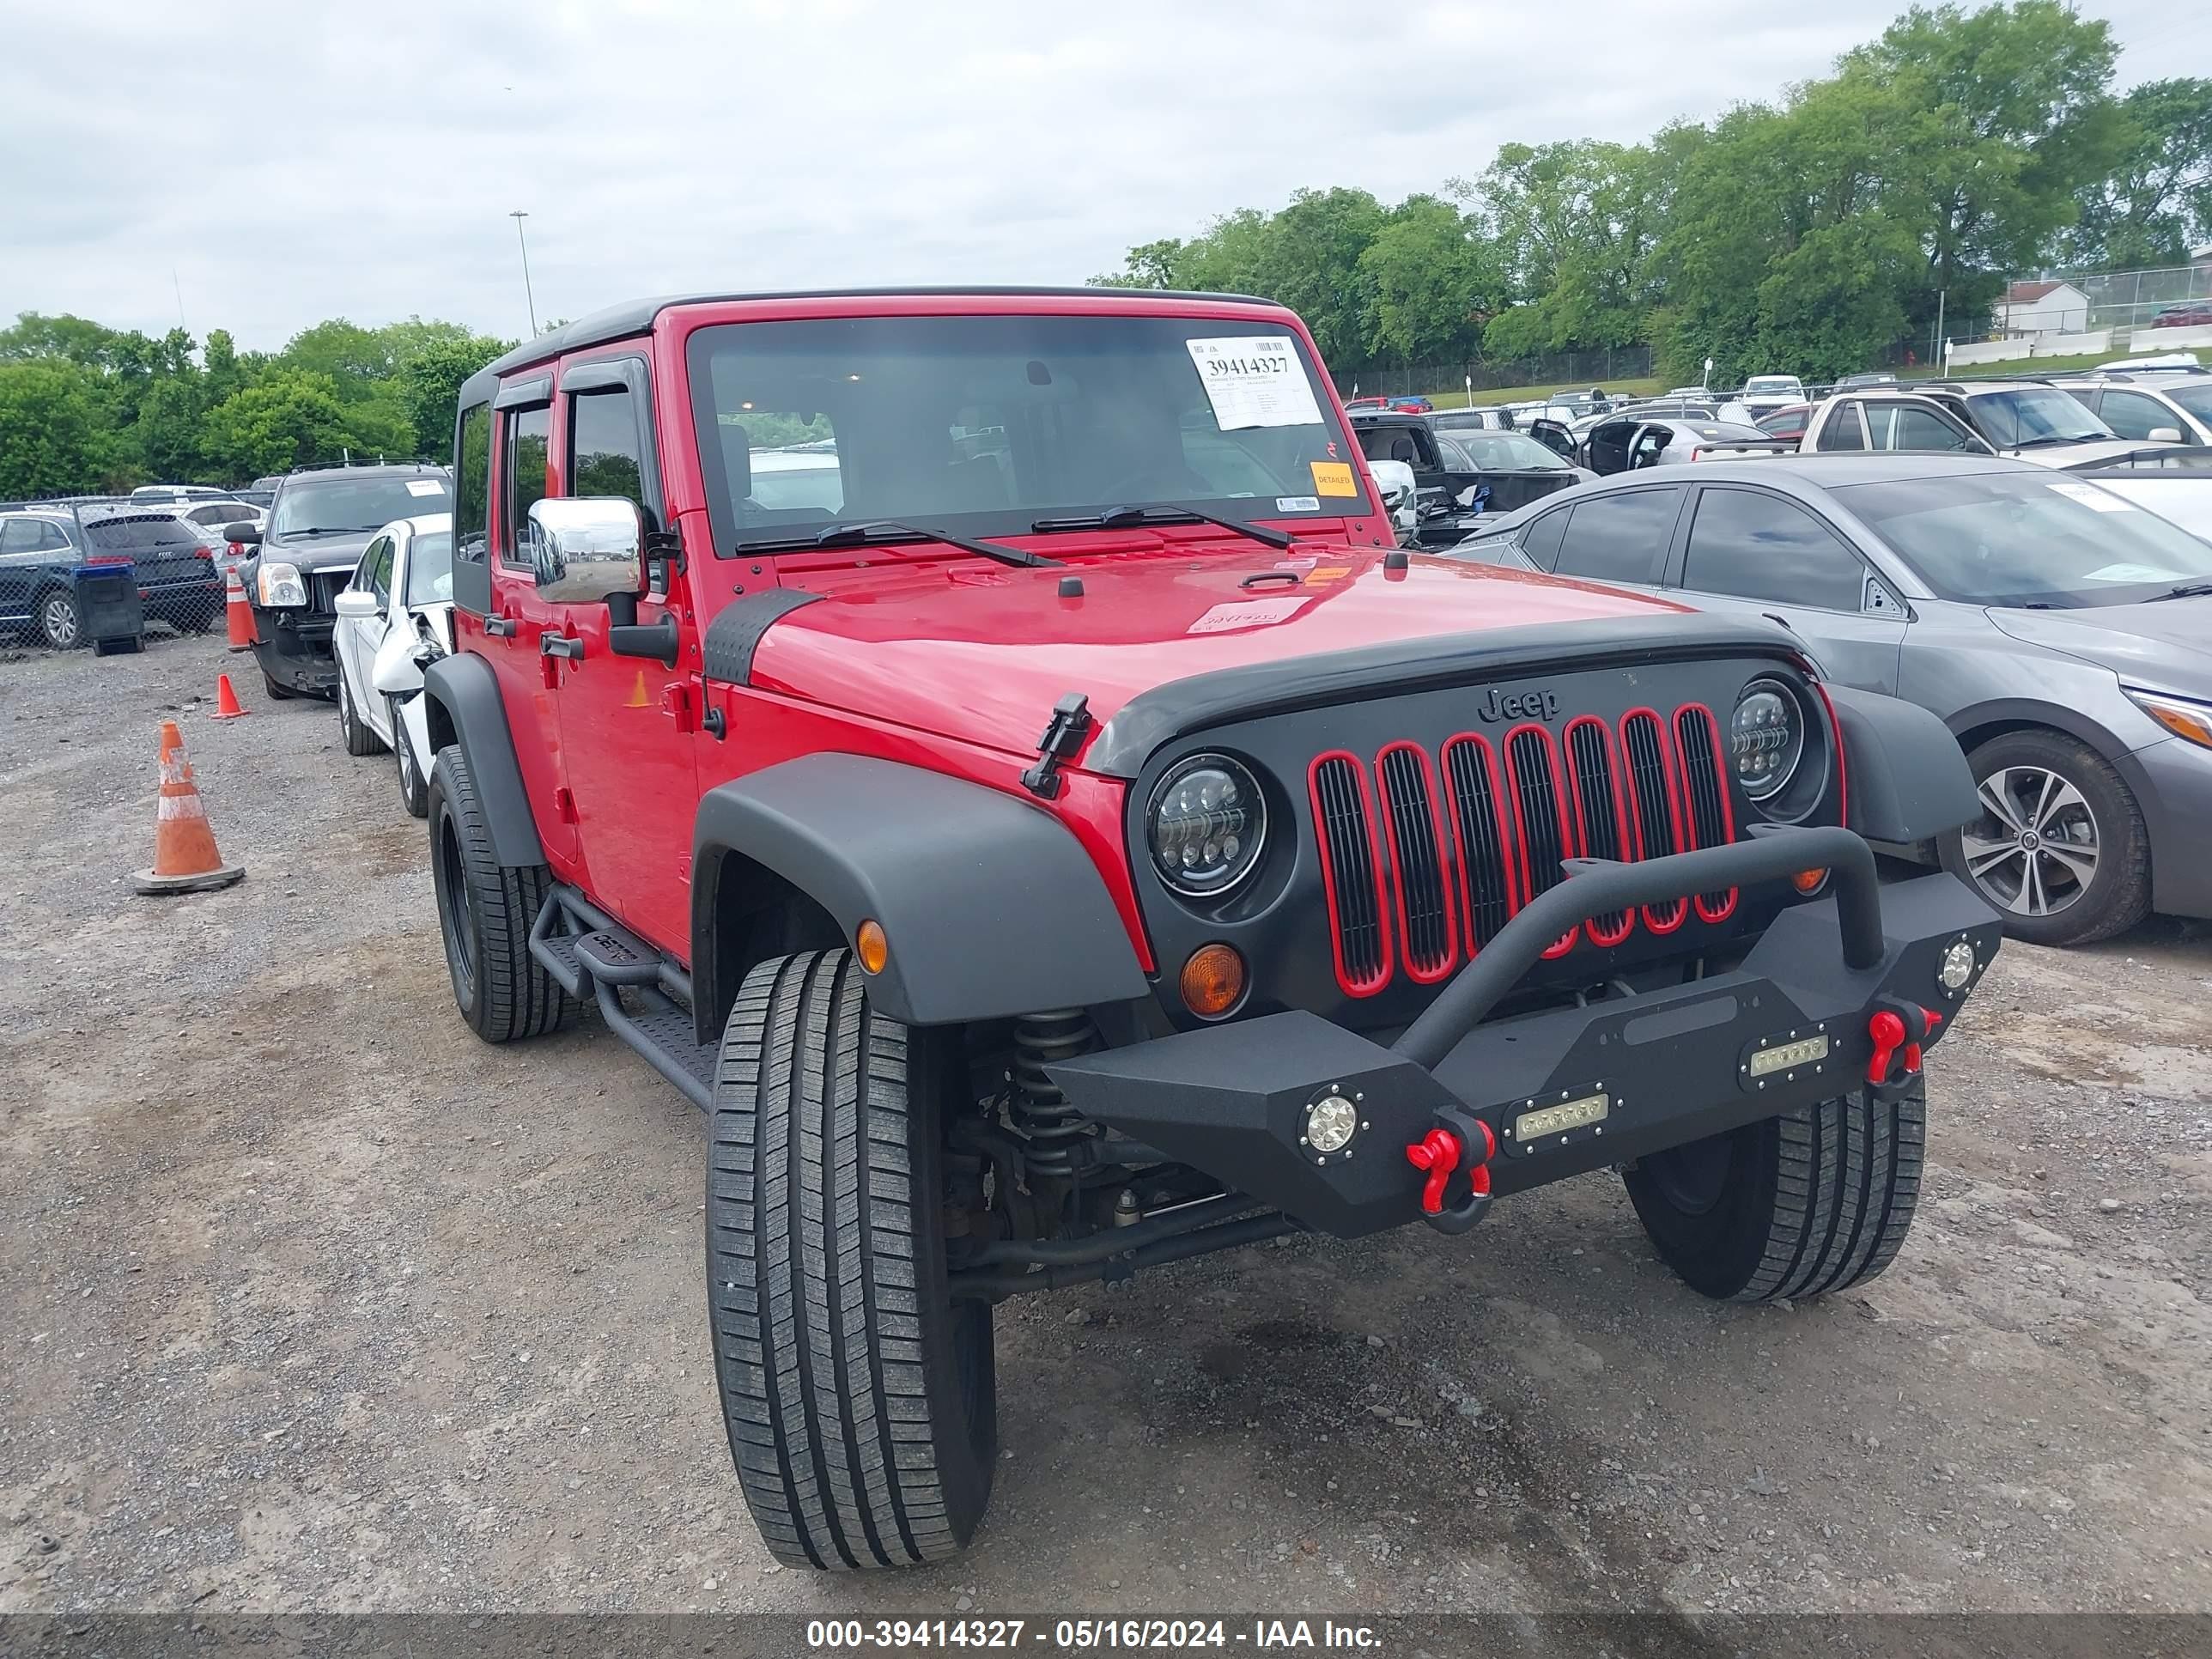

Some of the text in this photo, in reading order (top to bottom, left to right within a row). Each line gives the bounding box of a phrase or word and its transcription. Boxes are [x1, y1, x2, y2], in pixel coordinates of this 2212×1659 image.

[1206, 356, 1288, 376] 39414327
[1318, 476, 1350, 484] DETAILED
[1477, 689, 1561, 723] Jeep
